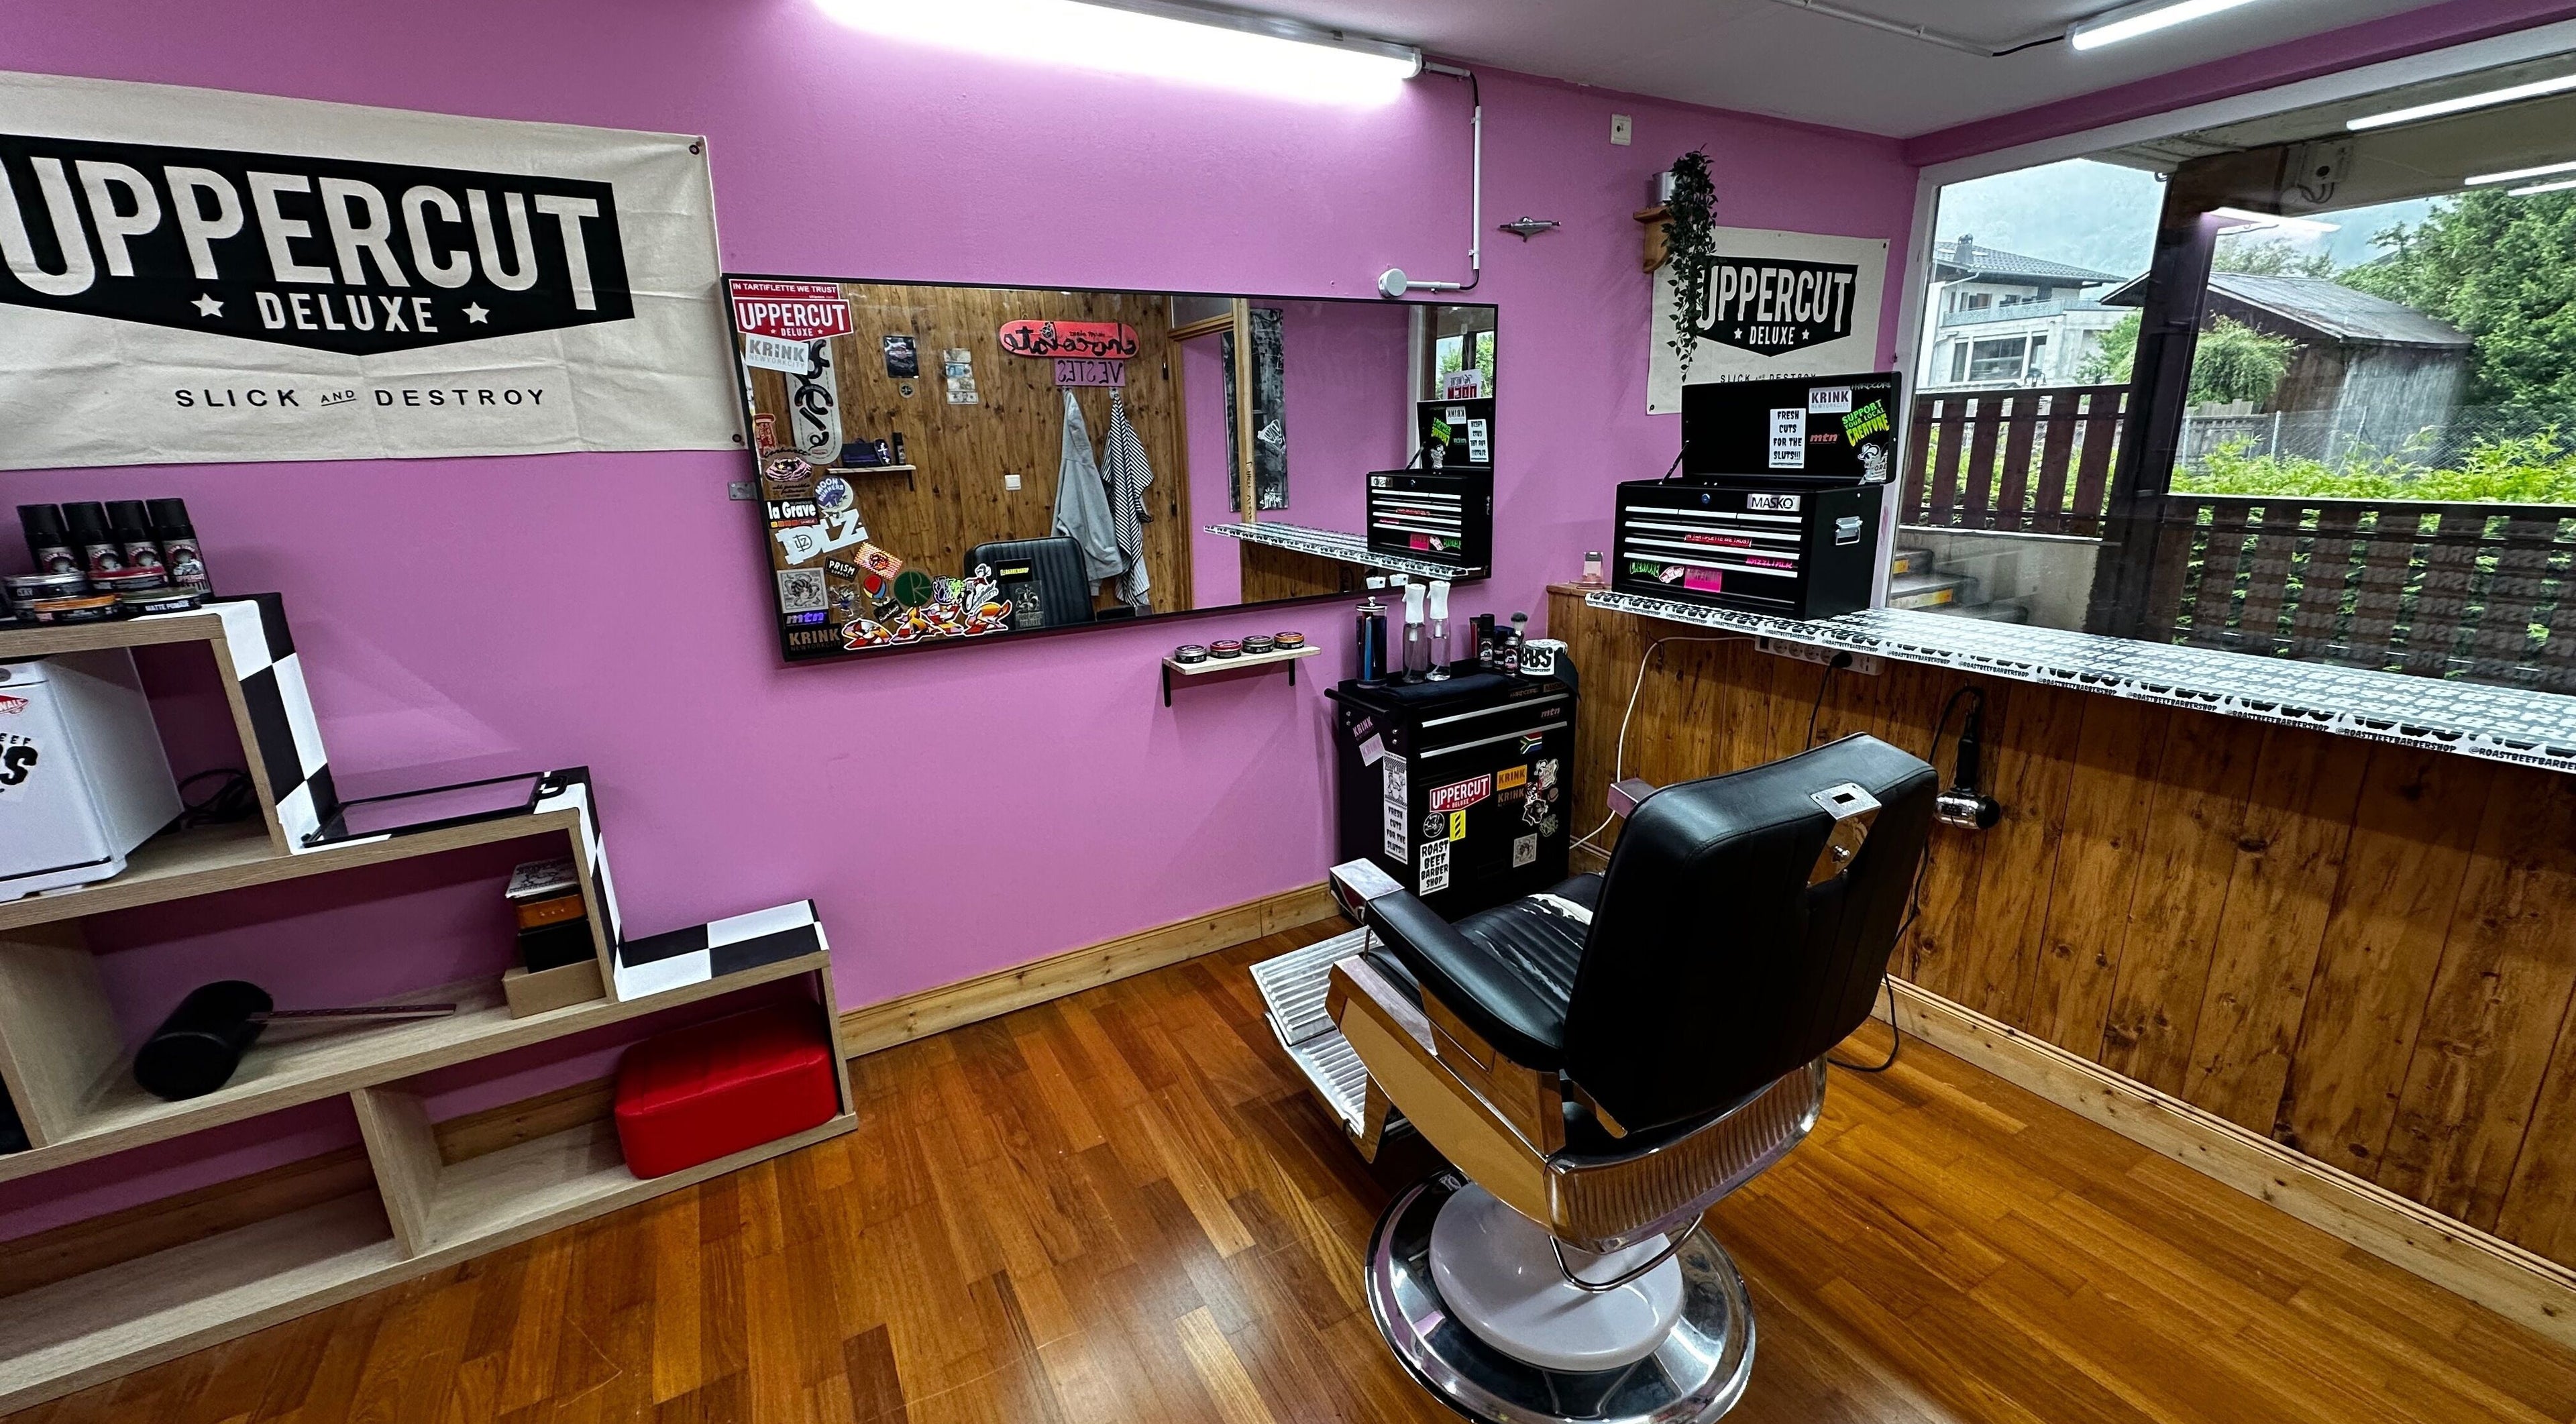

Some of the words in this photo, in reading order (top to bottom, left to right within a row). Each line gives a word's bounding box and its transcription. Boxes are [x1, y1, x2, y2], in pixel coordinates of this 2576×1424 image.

[0, 156, 599, 311] UPPERCUT
[744, 283, 795, 292] TARTIFLETTE
[1696, 265, 1852, 333] UPPERCUT
[259, 292, 438, 333] DELUXE
[738, 303, 845, 331] UPPERCUT
[781, 328, 813, 336] DELUXE
[1750, 326, 1795, 345] DELUXE
[749, 339, 804, 362] KRINK
[174, 388, 301, 408] SLICK
[320, 390, 357, 404] AND
[375, 388, 545, 406] DESTROY
[1811, 391, 1849, 404] KRINK
[1777, 410, 1799, 420] FRESH
[1841, 399, 1882, 425] SUPPORT
[1844, 417, 1863, 429] YOUR
[1864, 408, 1886, 421] LOCAL
[1779, 424, 1796, 433] CUTS
[1845, 413, 1890, 447] CREATURE
[1773, 437, 1786, 447] FOR
[1789, 437, 1803, 446] THE
[1809, 433, 1838, 442] mtn
[1773, 451, 1801, 460] SLUTS!!!
[815, 478, 838, 494] MOON
[818, 484, 844, 502] RUNNERS
[767, 502, 780, 519] la
[782, 502, 816, 518] Grave
[1752, 497, 1793, 509] MASKO
[828, 560, 855, 576] PRISM
[831, 569, 849, 578] SUPPLY
[786, 612, 826, 624] mtn
[789, 628, 840, 646] KRINK
[1958, 661, 2029, 677] @ROASTBEEFBARBERSHOP
[2037, 677, 2116, 696] @ROASTBEEFBARBERSHOP
[2126, 692, 2217, 712] @ROASTBEEFBARBERSHOP
[1541, 708, 1560, 718] mtn
[2225, 709, 2329, 731] @ROASTBEEFBARBERSHOP
[1352, 716, 1373, 737] KRINK
[2336, 726, 2456, 752] @ROASTBEEFBARBERSHOP
[1362, 739, 1382, 758] KRINK
[0, 743, 38, 785] S
[1499, 769, 1525, 784] KRINK
[1432, 777, 1489, 810] UPPERCUT
[1498, 787, 1525, 803] KRINK
[1452, 798, 1469, 808] DELUXE
[1388, 806, 1403, 820] FRESH
[1390, 818, 1402, 831] CUTS
[1387, 828, 1395, 840] FOR
[1396, 832, 1405, 844] THE
[1421, 839, 1448, 857] ROAST
[1424, 853, 1446, 869] BEEF
[1421, 864, 1448, 880] BARBER
[1426, 876, 1443, 888] SHOP
